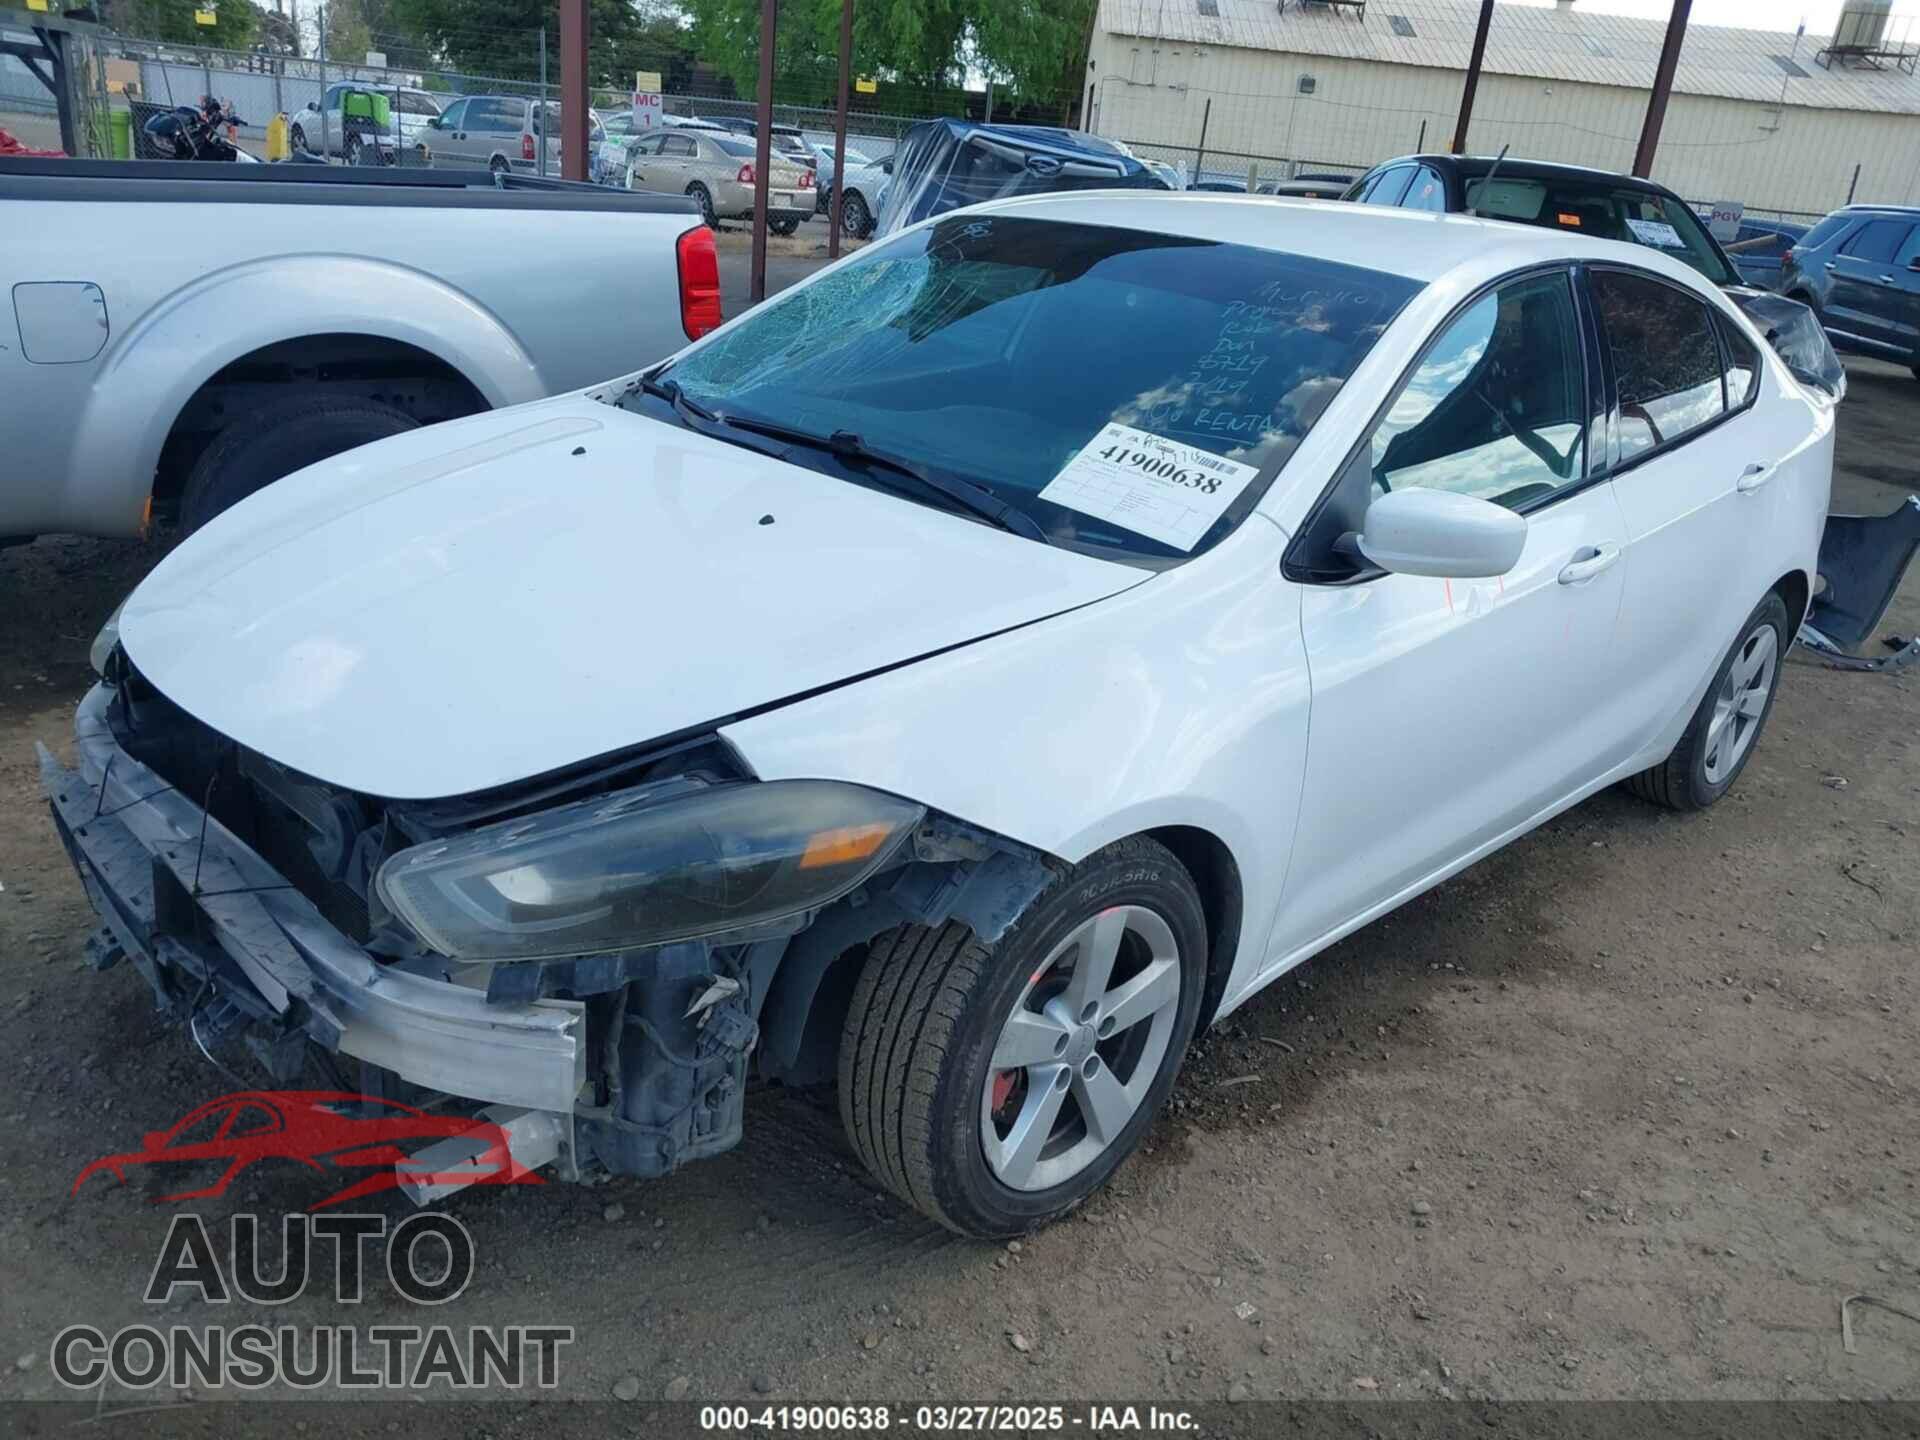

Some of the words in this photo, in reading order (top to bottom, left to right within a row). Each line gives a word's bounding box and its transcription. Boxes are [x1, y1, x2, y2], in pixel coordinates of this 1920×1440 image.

[635, 94, 660, 107] MC
[1711, 211, 1741, 221] PGV
[1099, 445, 1222, 495] 41900638
